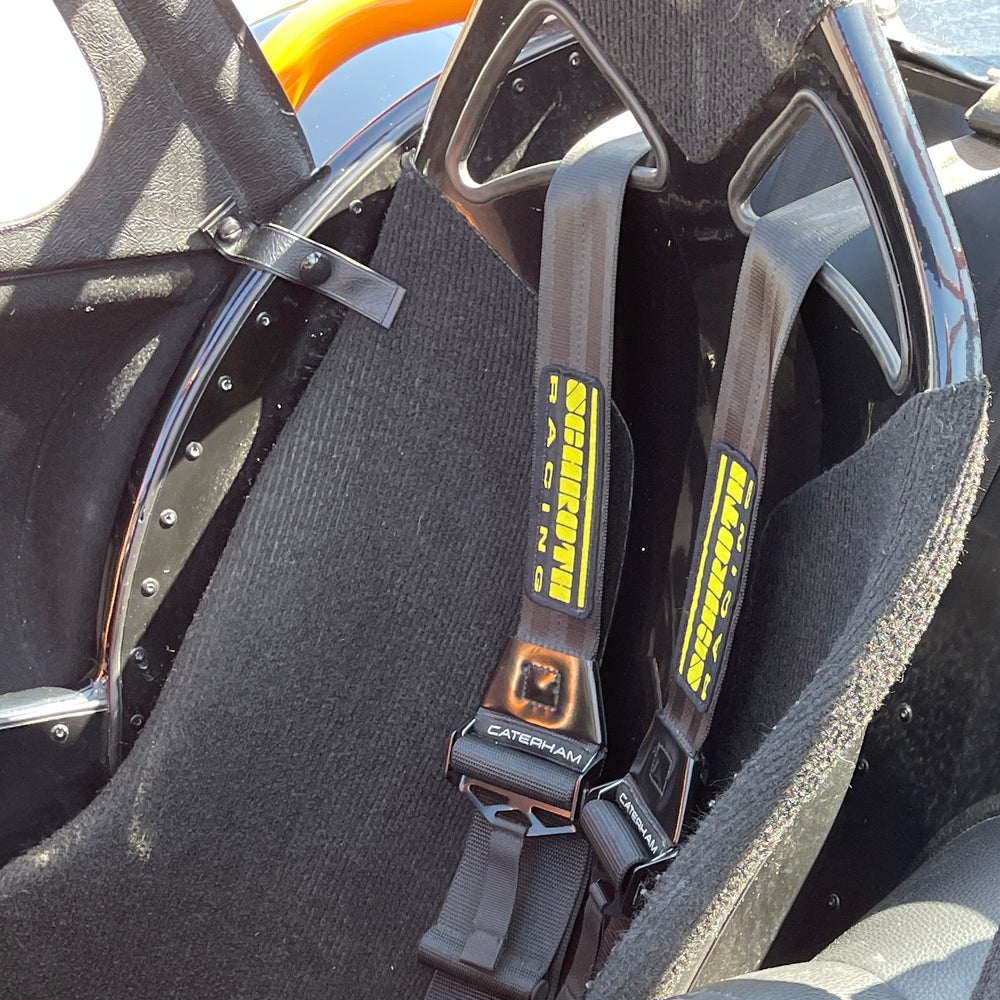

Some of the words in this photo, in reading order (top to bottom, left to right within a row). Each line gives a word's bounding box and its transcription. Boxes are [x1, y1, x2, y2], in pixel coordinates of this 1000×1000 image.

[533, 375, 559, 593] RACING
[549, 378, 587, 604] SCHROTH
[686, 460, 748, 693] SCHROTH
[487, 724, 583, 766] CATERHAM
[617, 791, 658, 855] CATERHAM
